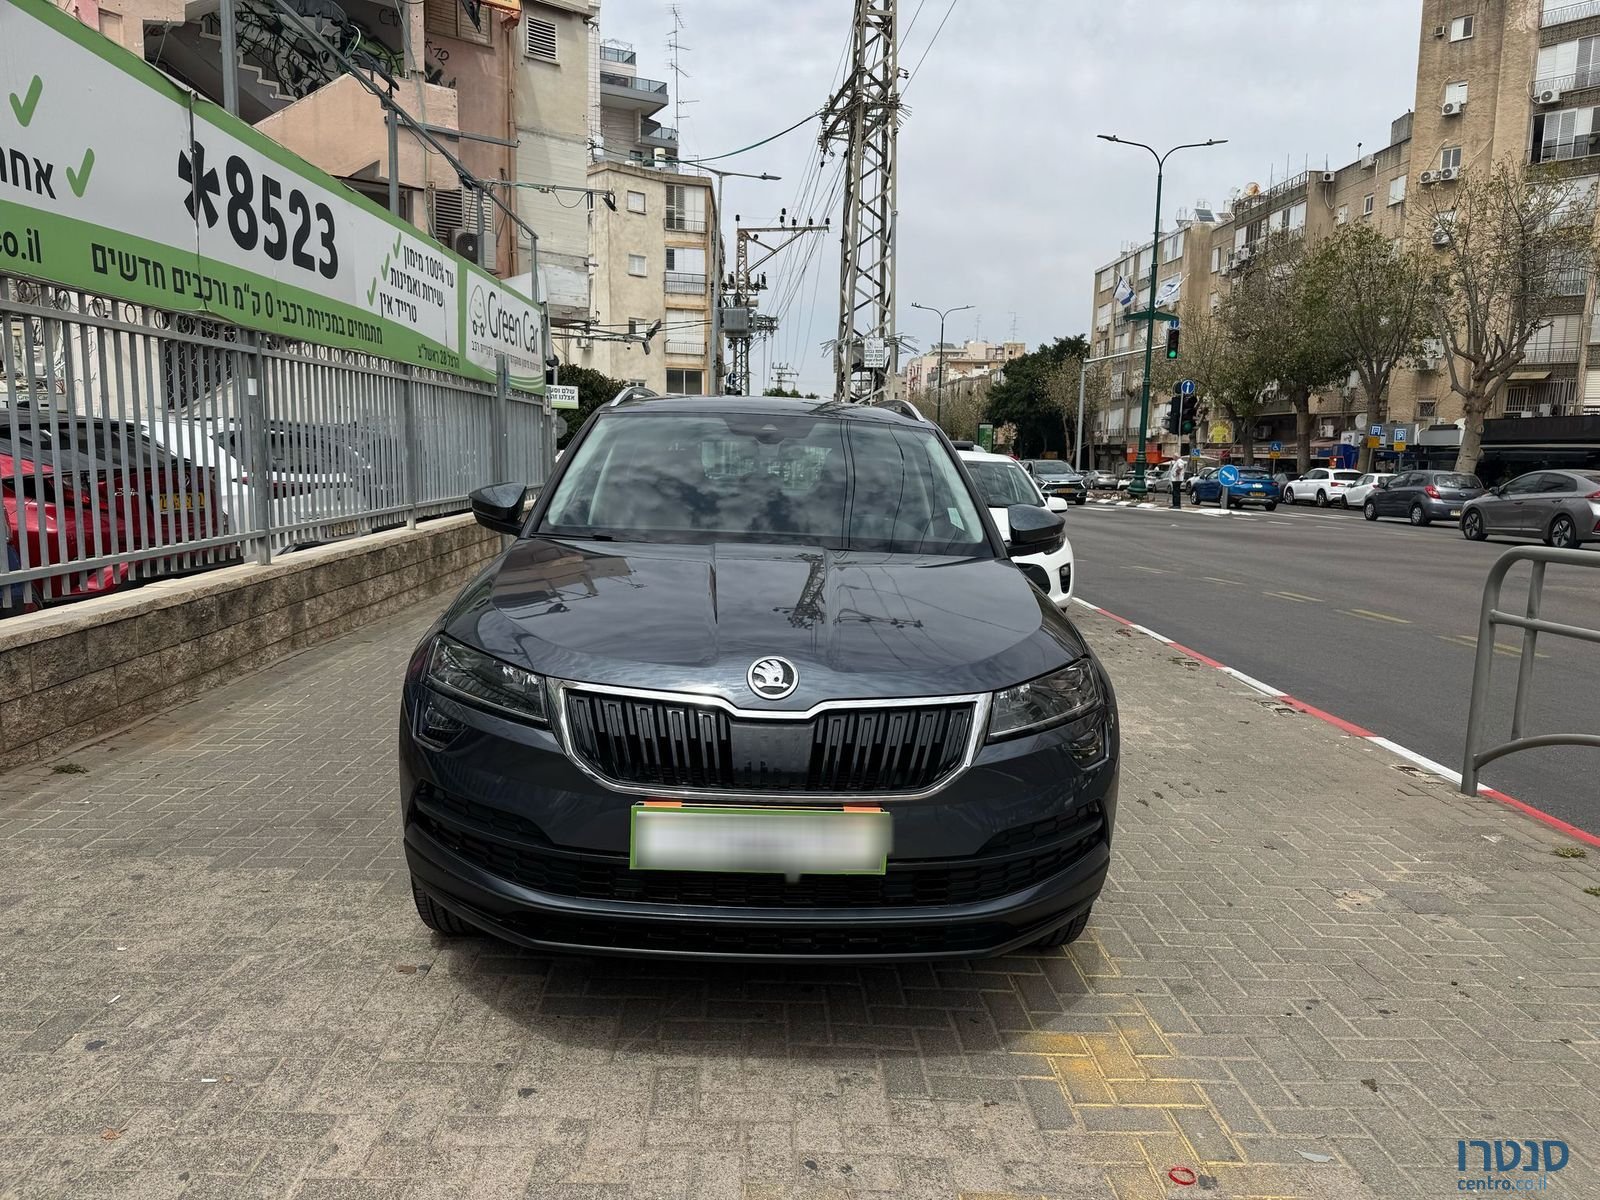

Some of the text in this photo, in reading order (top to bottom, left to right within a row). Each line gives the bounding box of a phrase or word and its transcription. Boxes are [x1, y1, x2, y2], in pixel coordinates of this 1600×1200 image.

[0, 228, 42, 264] o.il
[91, 242, 166, 290] חדשים
[403, 245, 454, 288] עד 100% מימון
[172, 266, 228, 306] ורכבים
[390, 267, 443, 307] שירות ואמינות
[265, 291, 274, 318] 0
[276, 299, 304, 326] רכבי
[307, 307, 345, 335] במכירת
[380, 292, 417, 323] טרייד אין
[348, 318, 383, 344] מתמחים
[488, 291, 539, 355] Green Car
